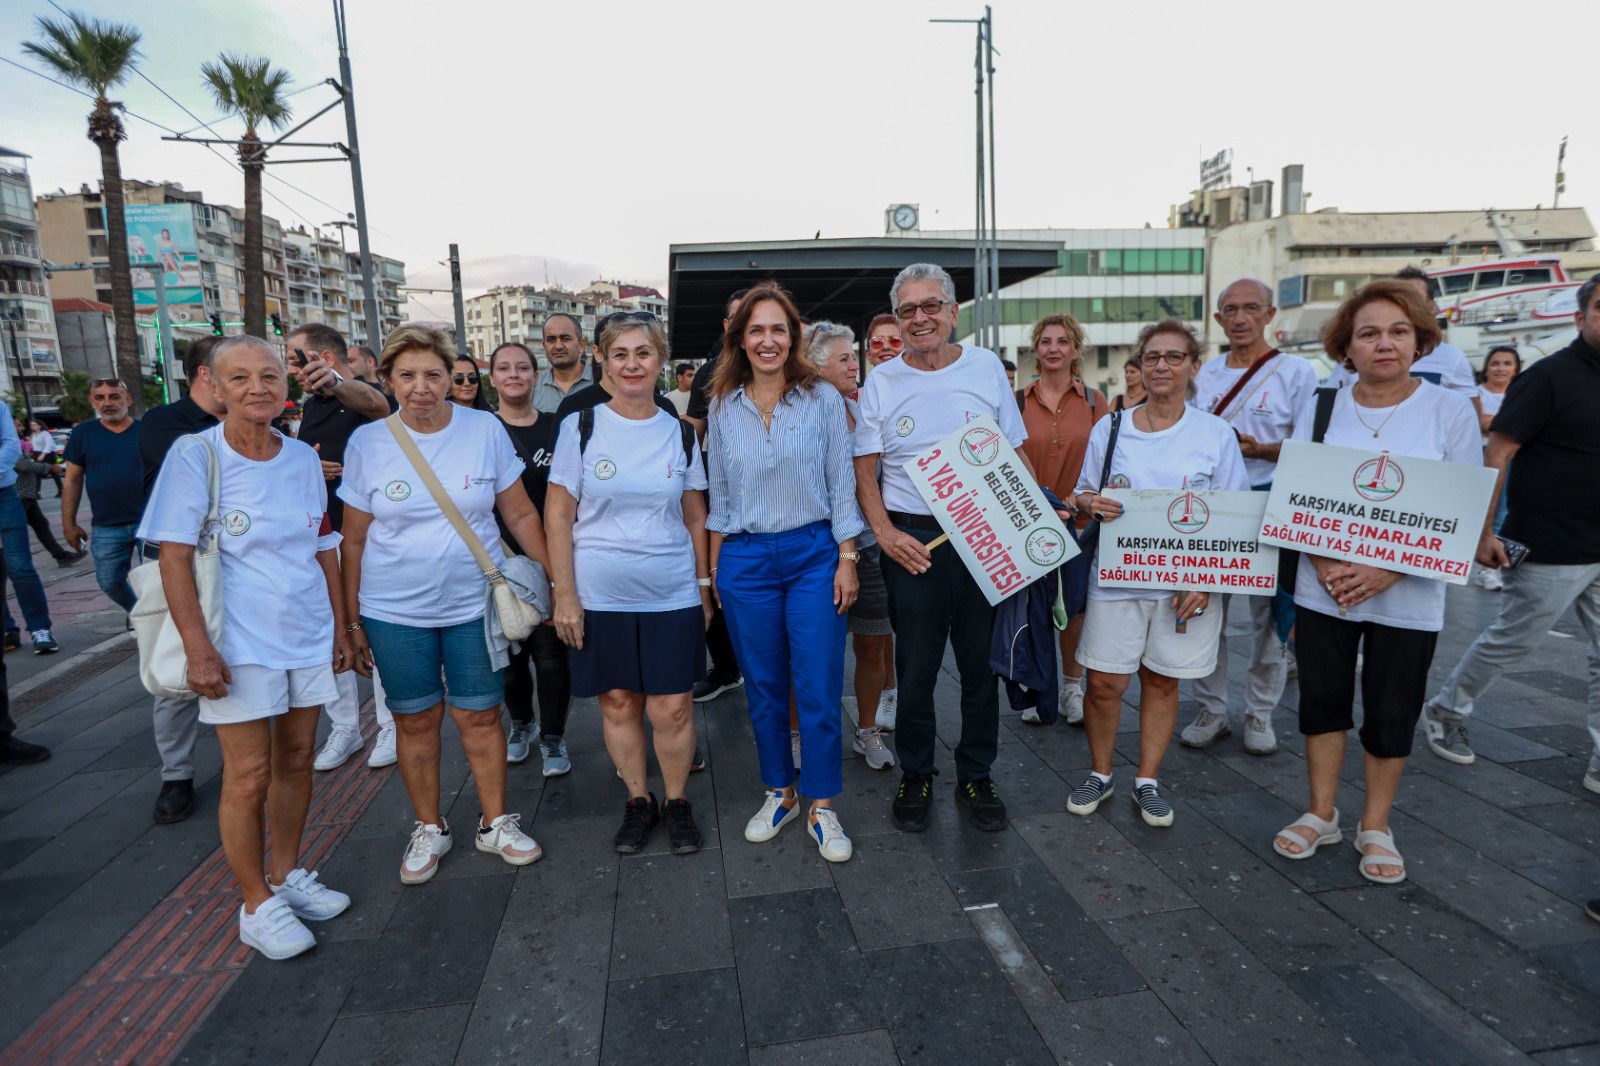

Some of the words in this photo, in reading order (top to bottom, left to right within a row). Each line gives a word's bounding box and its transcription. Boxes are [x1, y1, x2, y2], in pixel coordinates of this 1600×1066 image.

[917, 449, 942, 472] 3.
[927, 462, 964, 503] YAŞ
[983, 471, 1029, 532] BELEDİYESİ
[998, 462, 1043, 523] KARŞIYAKA
[1288, 493, 1366, 518] KARŞIYAKA
[1370, 508, 1459, 534] BELEDİYESİ
[1292, 511, 1343, 532] BİLGE
[1348, 522, 1443, 551] ÇINARLAR
[946, 489, 1031, 596] ÜNİVERSİTESİ
[1117, 537, 1184, 551] KARŞIYAKA
[1188, 537, 1259, 553] BELEDİYESİ
[1123, 552, 1167, 566] BİLGE
[1172, 555, 1251, 570] ÇINARLAR
[1262, 524, 1322, 547] SAĞLIKLI
[1327, 537, 1352, 554] YAŞ
[1355, 544, 1396, 562] ALMA
[1400, 553, 1471, 577] MERKEZİ
[1100, 566, 1152, 582] SAĞLIKLI
[1156, 571, 1178, 586] YAŞ
[1182, 573, 1216, 585] ALMA
[1220, 574, 1275, 588] MERKEZİ
